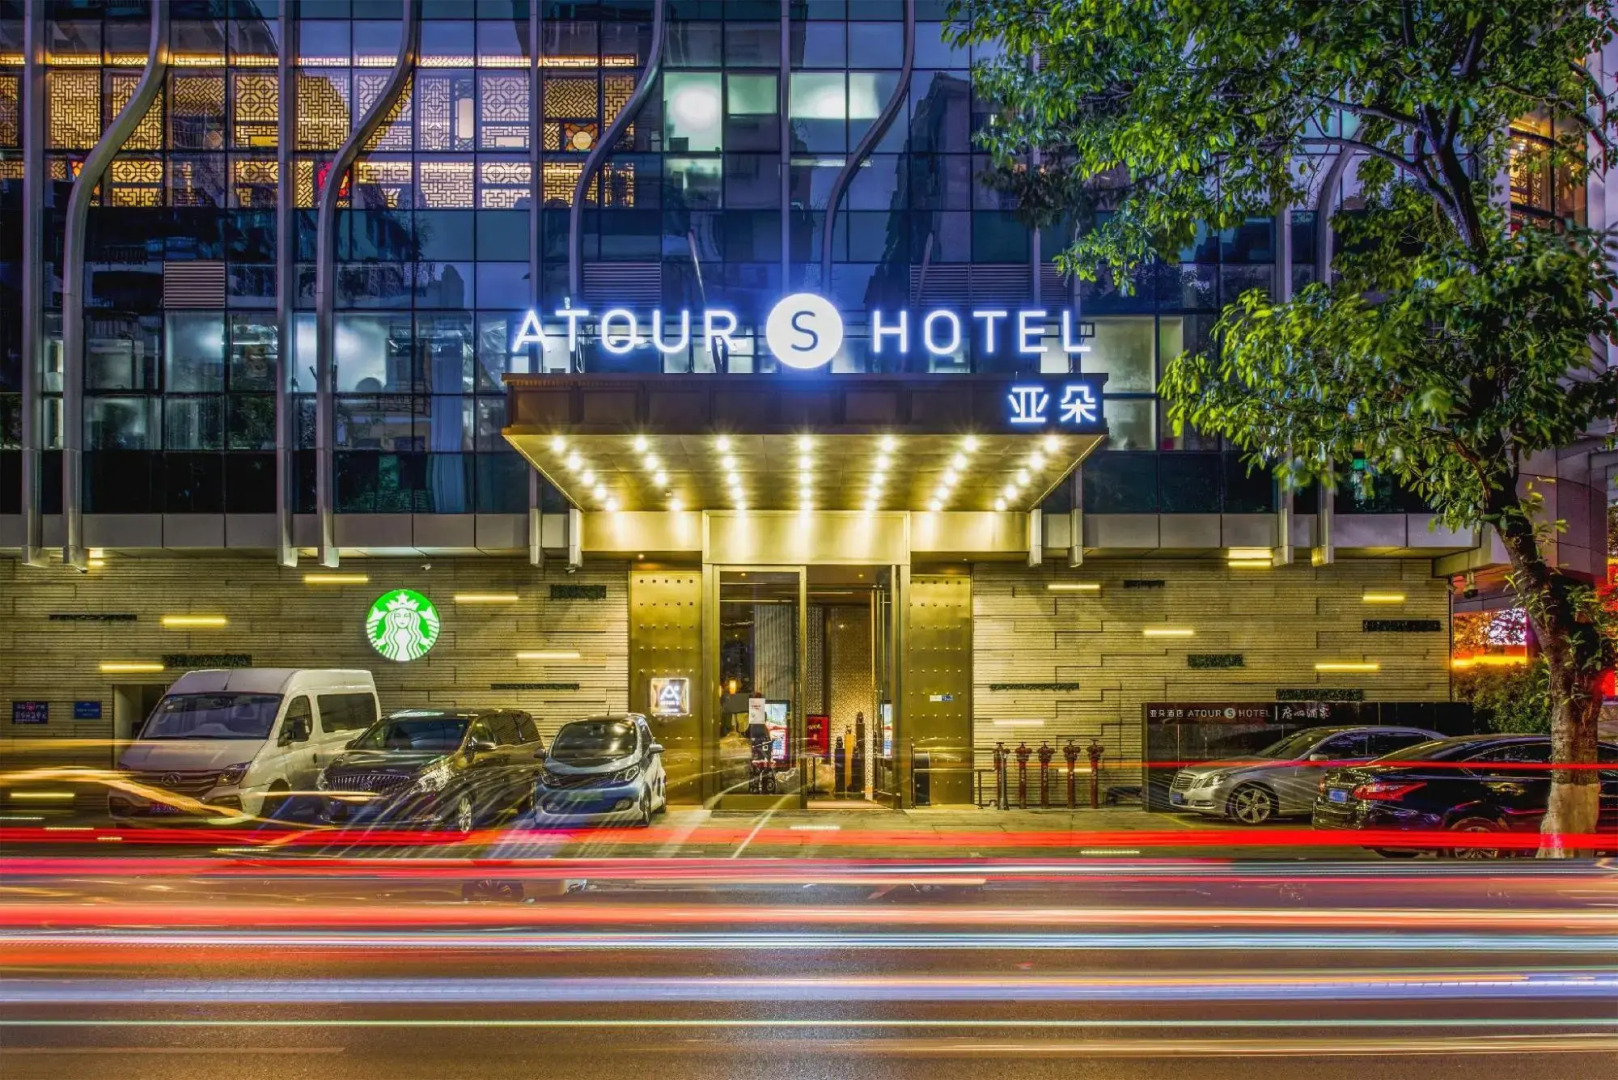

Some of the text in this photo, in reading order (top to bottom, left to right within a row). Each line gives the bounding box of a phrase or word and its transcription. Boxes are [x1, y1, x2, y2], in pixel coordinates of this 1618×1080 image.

[512, 309, 1091, 354] ATOUR S HOTEL
[1007, 385, 1097, 425] 亚朵
[1149, 709, 1184, 718] 亚朵酒店
[1187, 709, 1222, 718] ATOUR
[1238, 709, 1271, 718] HOTEL
